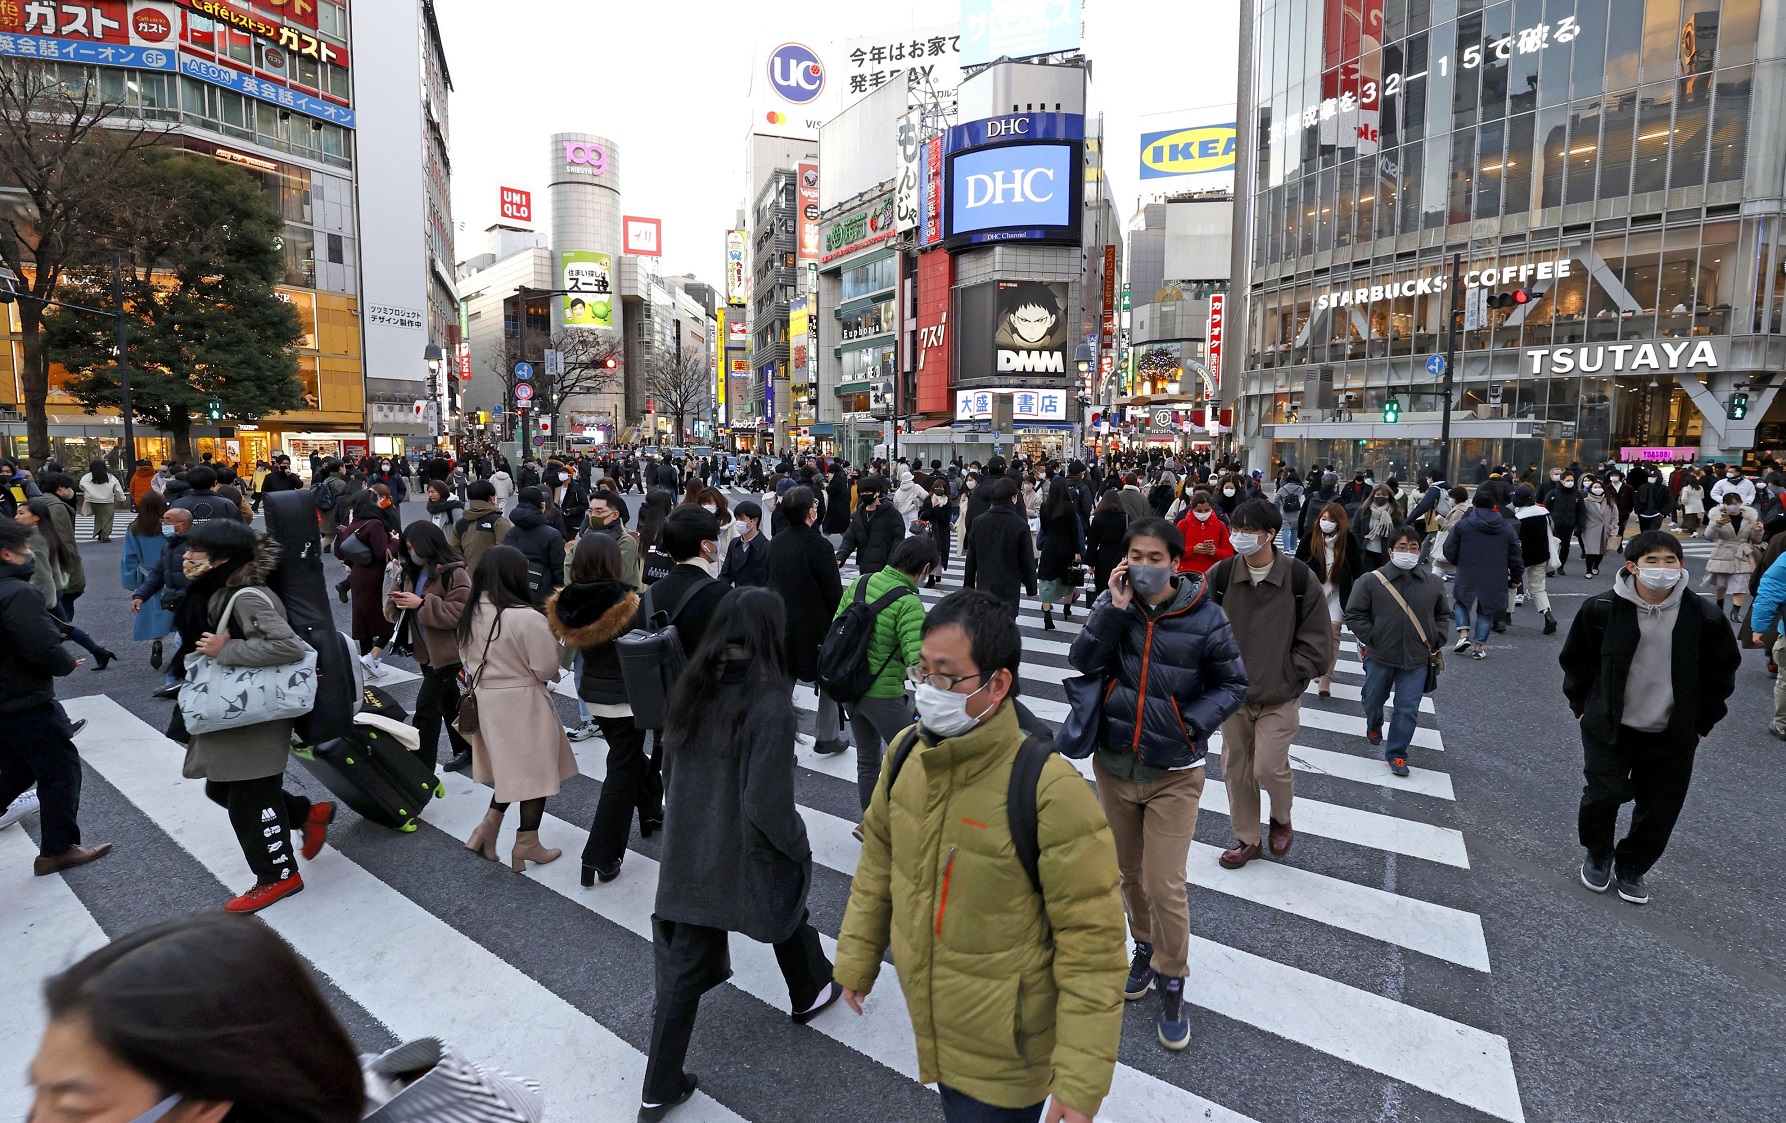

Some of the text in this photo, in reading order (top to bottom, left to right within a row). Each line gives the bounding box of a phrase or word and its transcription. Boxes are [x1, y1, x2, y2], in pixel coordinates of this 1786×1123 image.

[25, 1, 119, 38] ガスト
[138, 23, 167, 34] ガスト
[279, 26, 337, 62] ガスト
[145, 53, 163, 64] 6F
[187, 59, 232, 84] AEON
[986, 117, 1030, 138] DHC
[562, 140, 607, 176] 109
[1152, 136, 1237, 164] IKEA
[566, 165, 592, 175] SHIBUYA
[896, 115, 917, 225] もんじゃ
[503, 190, 526, 206] UNI
[965, 167, 1055, 209] DHC
[503, 203, 529, 218] QLO
[987, 232, 1027, 241] DHC Channel
[1317, 275, 1449, 311] STARBUCKS
[1463, 258, 1572, 289] COFFEE
[370, 306, 421, 319] ツツミプロジェクト
[370, 314, 422, 328] デザイン製作中
[843, 324, 880, 339] Euphoria
[1211, 301, 1222, 348] カラオケ
[997, 349, 1065, 373] DMM
[1526, 340, 1718, 375] TSUTAYA
[961, 394, 1059, 414] 大盛書店
[1643, 450, 1671, 459] YOASOBI
